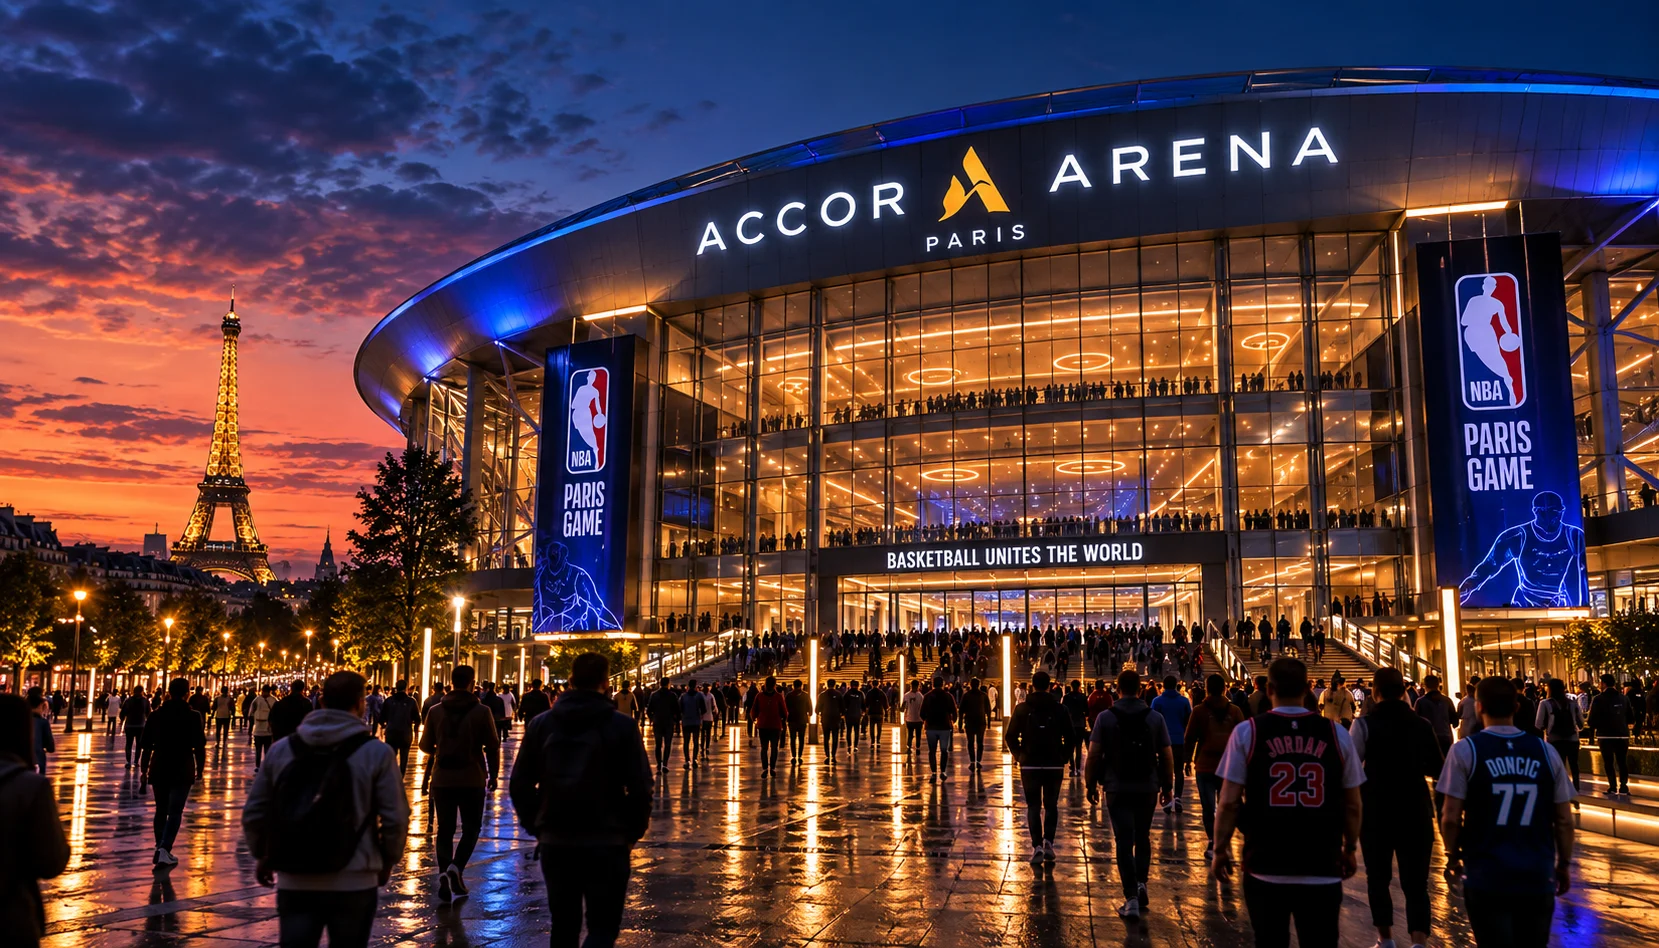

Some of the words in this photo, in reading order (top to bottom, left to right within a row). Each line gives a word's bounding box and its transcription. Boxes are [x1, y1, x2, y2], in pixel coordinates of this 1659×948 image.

[697, 182, 906, 256] ACCOR
[1049, 127, 1339, 193] ARENA
[926, 224, 1026, 252] PARIS
[1470, 380, 1503, 402] NBA
[1464, 420, 1532, 456] PARIS
[571, 450, 592, 468] NBA
[1467, 456, 1534, 492] GAME
[564, 481, 605, 509] PARIS
[563, 509, 603, 538] GAME
[887, 549, 980, 570] BASKETBALL
[985, 546, 1041, 566] UNITES
[1046, 545, 1078, 564] THE
[1082, 542, 1143, 562] WORLD
[1266, 735, 1328, 759] JORDAN
[1485, 756, 1541, 779] DONCIC
[1269, 762, 1325, 808] 23
[1491, 783, 1539, 827] 77
